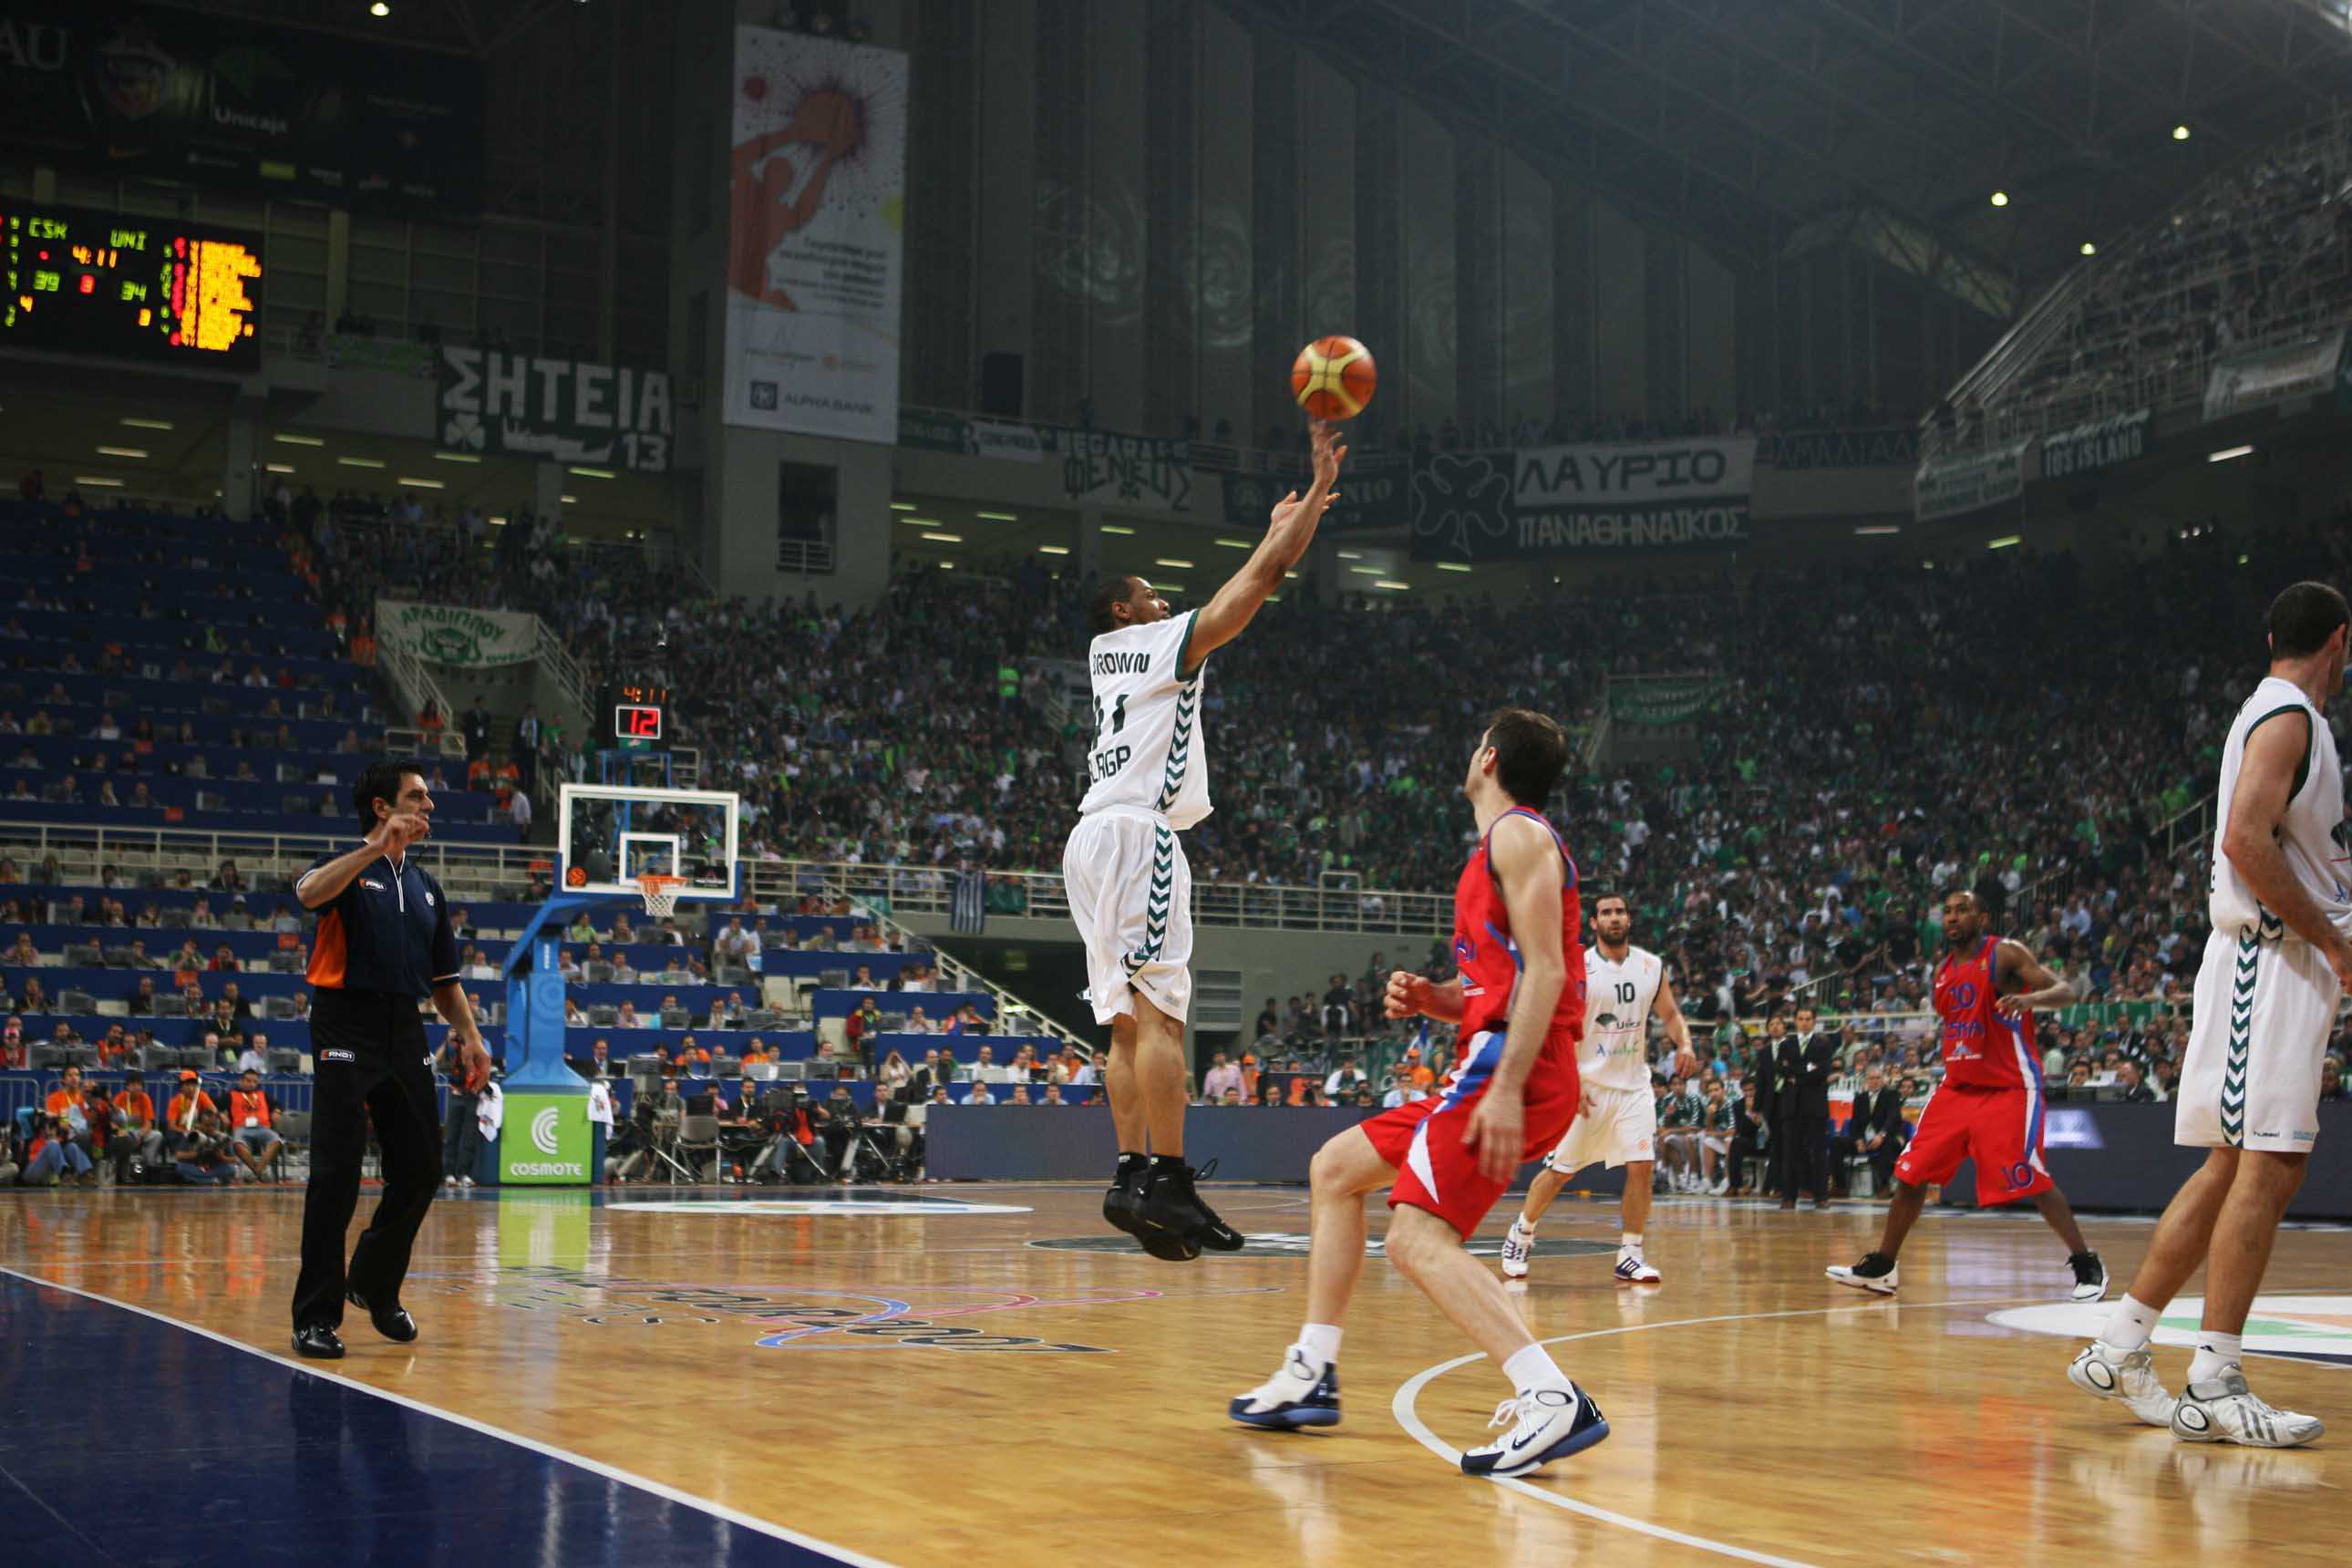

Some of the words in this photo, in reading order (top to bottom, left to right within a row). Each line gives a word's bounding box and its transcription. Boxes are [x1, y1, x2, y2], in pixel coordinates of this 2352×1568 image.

[109, 229, 148, 251] UNI
[120, 280, 148, 302] 34
[443, 346, 671, 436] ΣΗΤΕΙΑ
[624, 433, 667, 471] 13
[1517, 449, 1727, 494] ΛΑΥΡΙΟ
[624, 686, 666, 705] 4:11
[630, 709, 658, 737] 12
[1614, 982, 1635, 1005] 10
[511, 1162, 583, 1177] COSMOTE
[2001, 1162, 2035, 1192] 10
